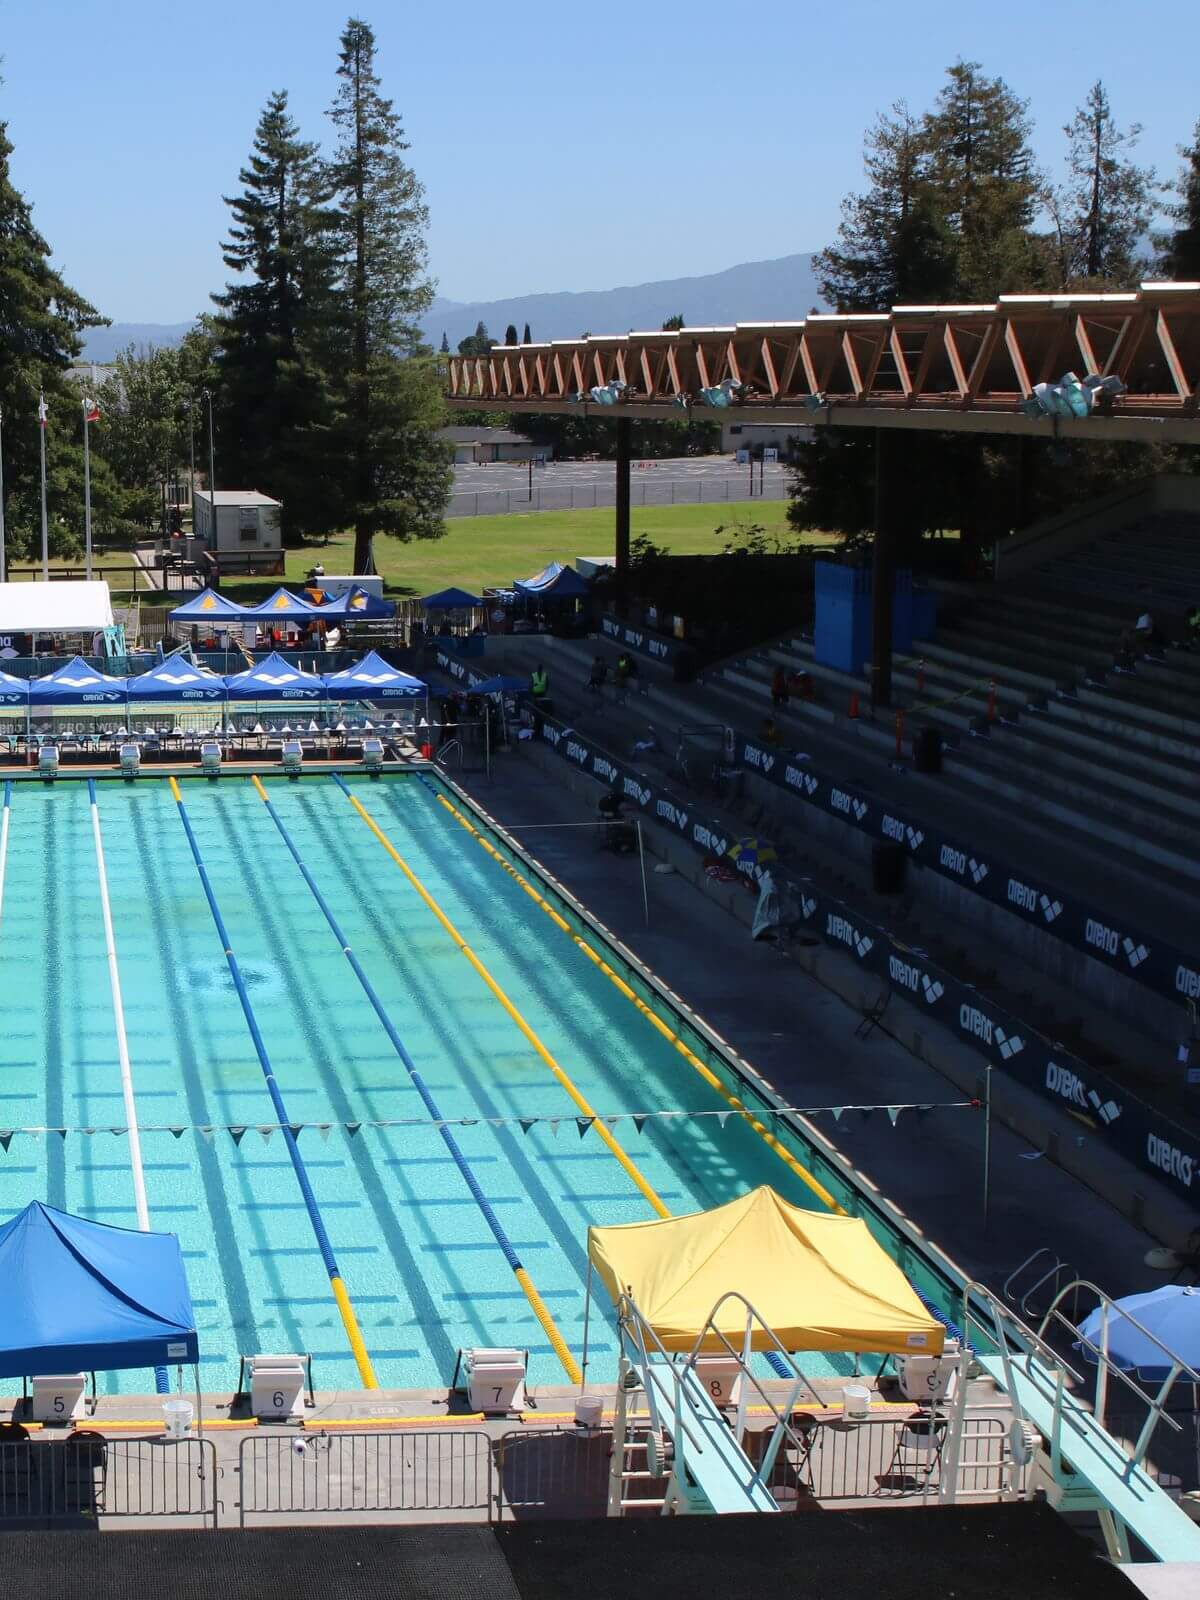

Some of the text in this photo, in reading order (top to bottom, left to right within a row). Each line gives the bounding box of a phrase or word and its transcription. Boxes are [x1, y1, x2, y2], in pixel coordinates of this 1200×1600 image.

[58, 723, 87, 734] PRO
[881, 813, 905, 843] arena
[940, 843, 966, 876] arena
[1007, 878, 1038, 912] arena
[1085, 917, 1120, 957] arena
[889, 954, 919, 992] arena
[960, 1003, 993, 1046] arena
[1046, 1061, 1089, 1110] arena
[1147, 1132, 1193, 1189] arena
[53, 1396, 65, 1413] 5
[273, 1391, 284, 1408] 6
[492, 1387, 503, 1403] 7
[710, 1380, 722, 1397] 8
